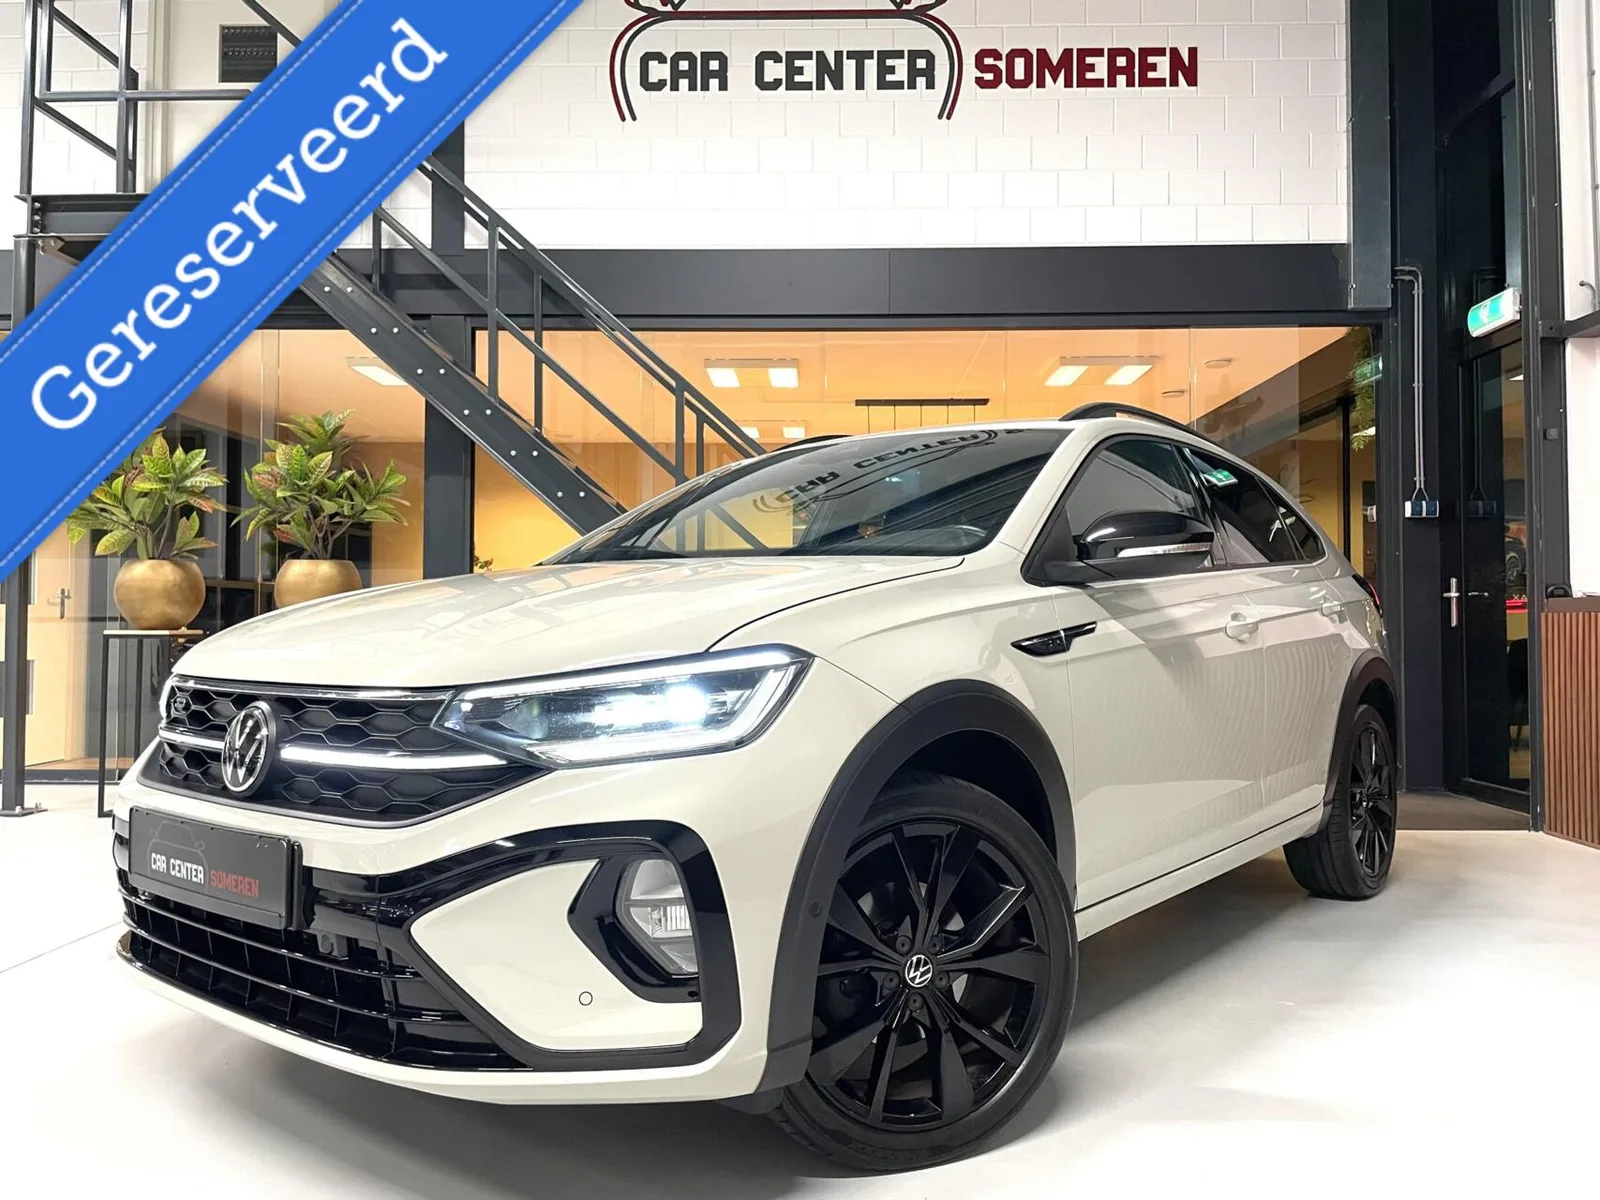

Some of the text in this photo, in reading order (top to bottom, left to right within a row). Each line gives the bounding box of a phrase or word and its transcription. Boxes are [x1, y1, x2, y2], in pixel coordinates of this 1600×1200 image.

[639, 46, 1198, 92] CAR CENTER SOMEREN
[151, 852, 259, 897] CAR CENTER SOMEREN
